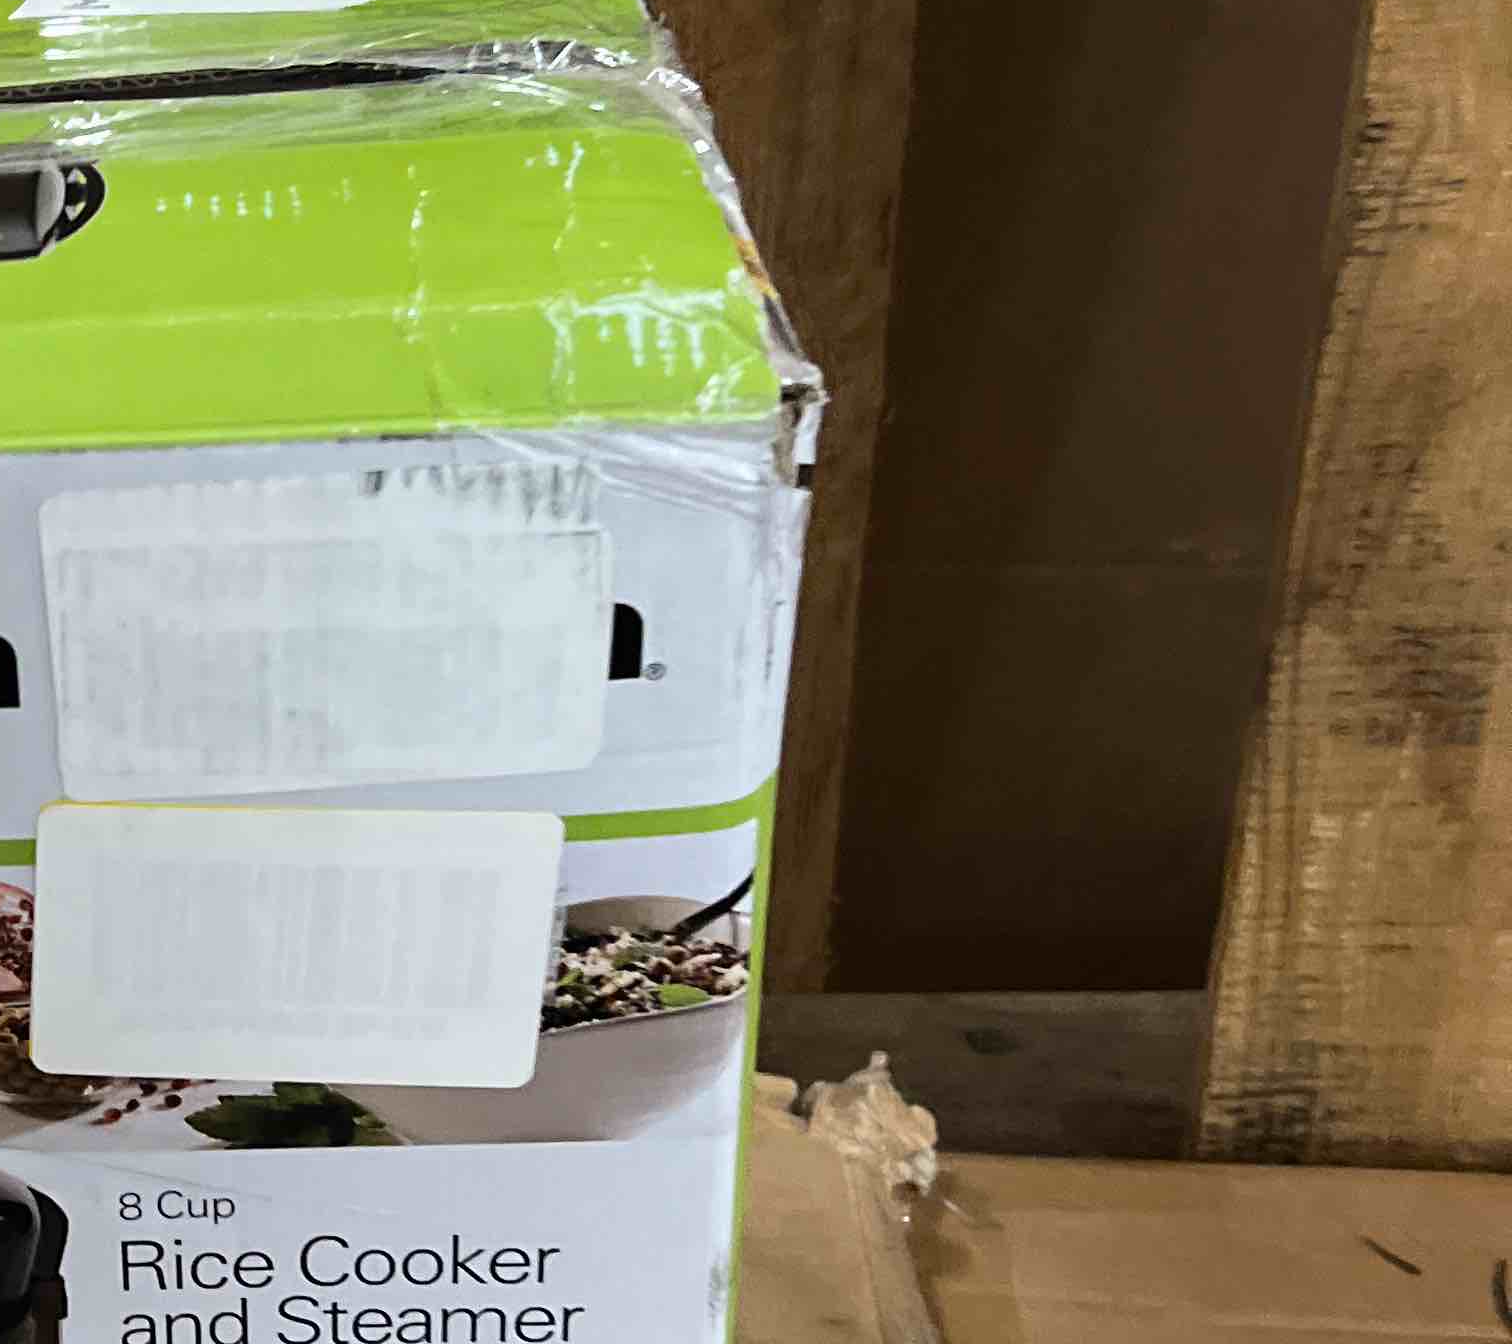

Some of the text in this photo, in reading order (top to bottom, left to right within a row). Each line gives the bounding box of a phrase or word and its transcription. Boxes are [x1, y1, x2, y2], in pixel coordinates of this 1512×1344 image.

[118, 1190, 235, 1225] 8 Cup
[120, 1234, 561, 1292] Rice Cooker
